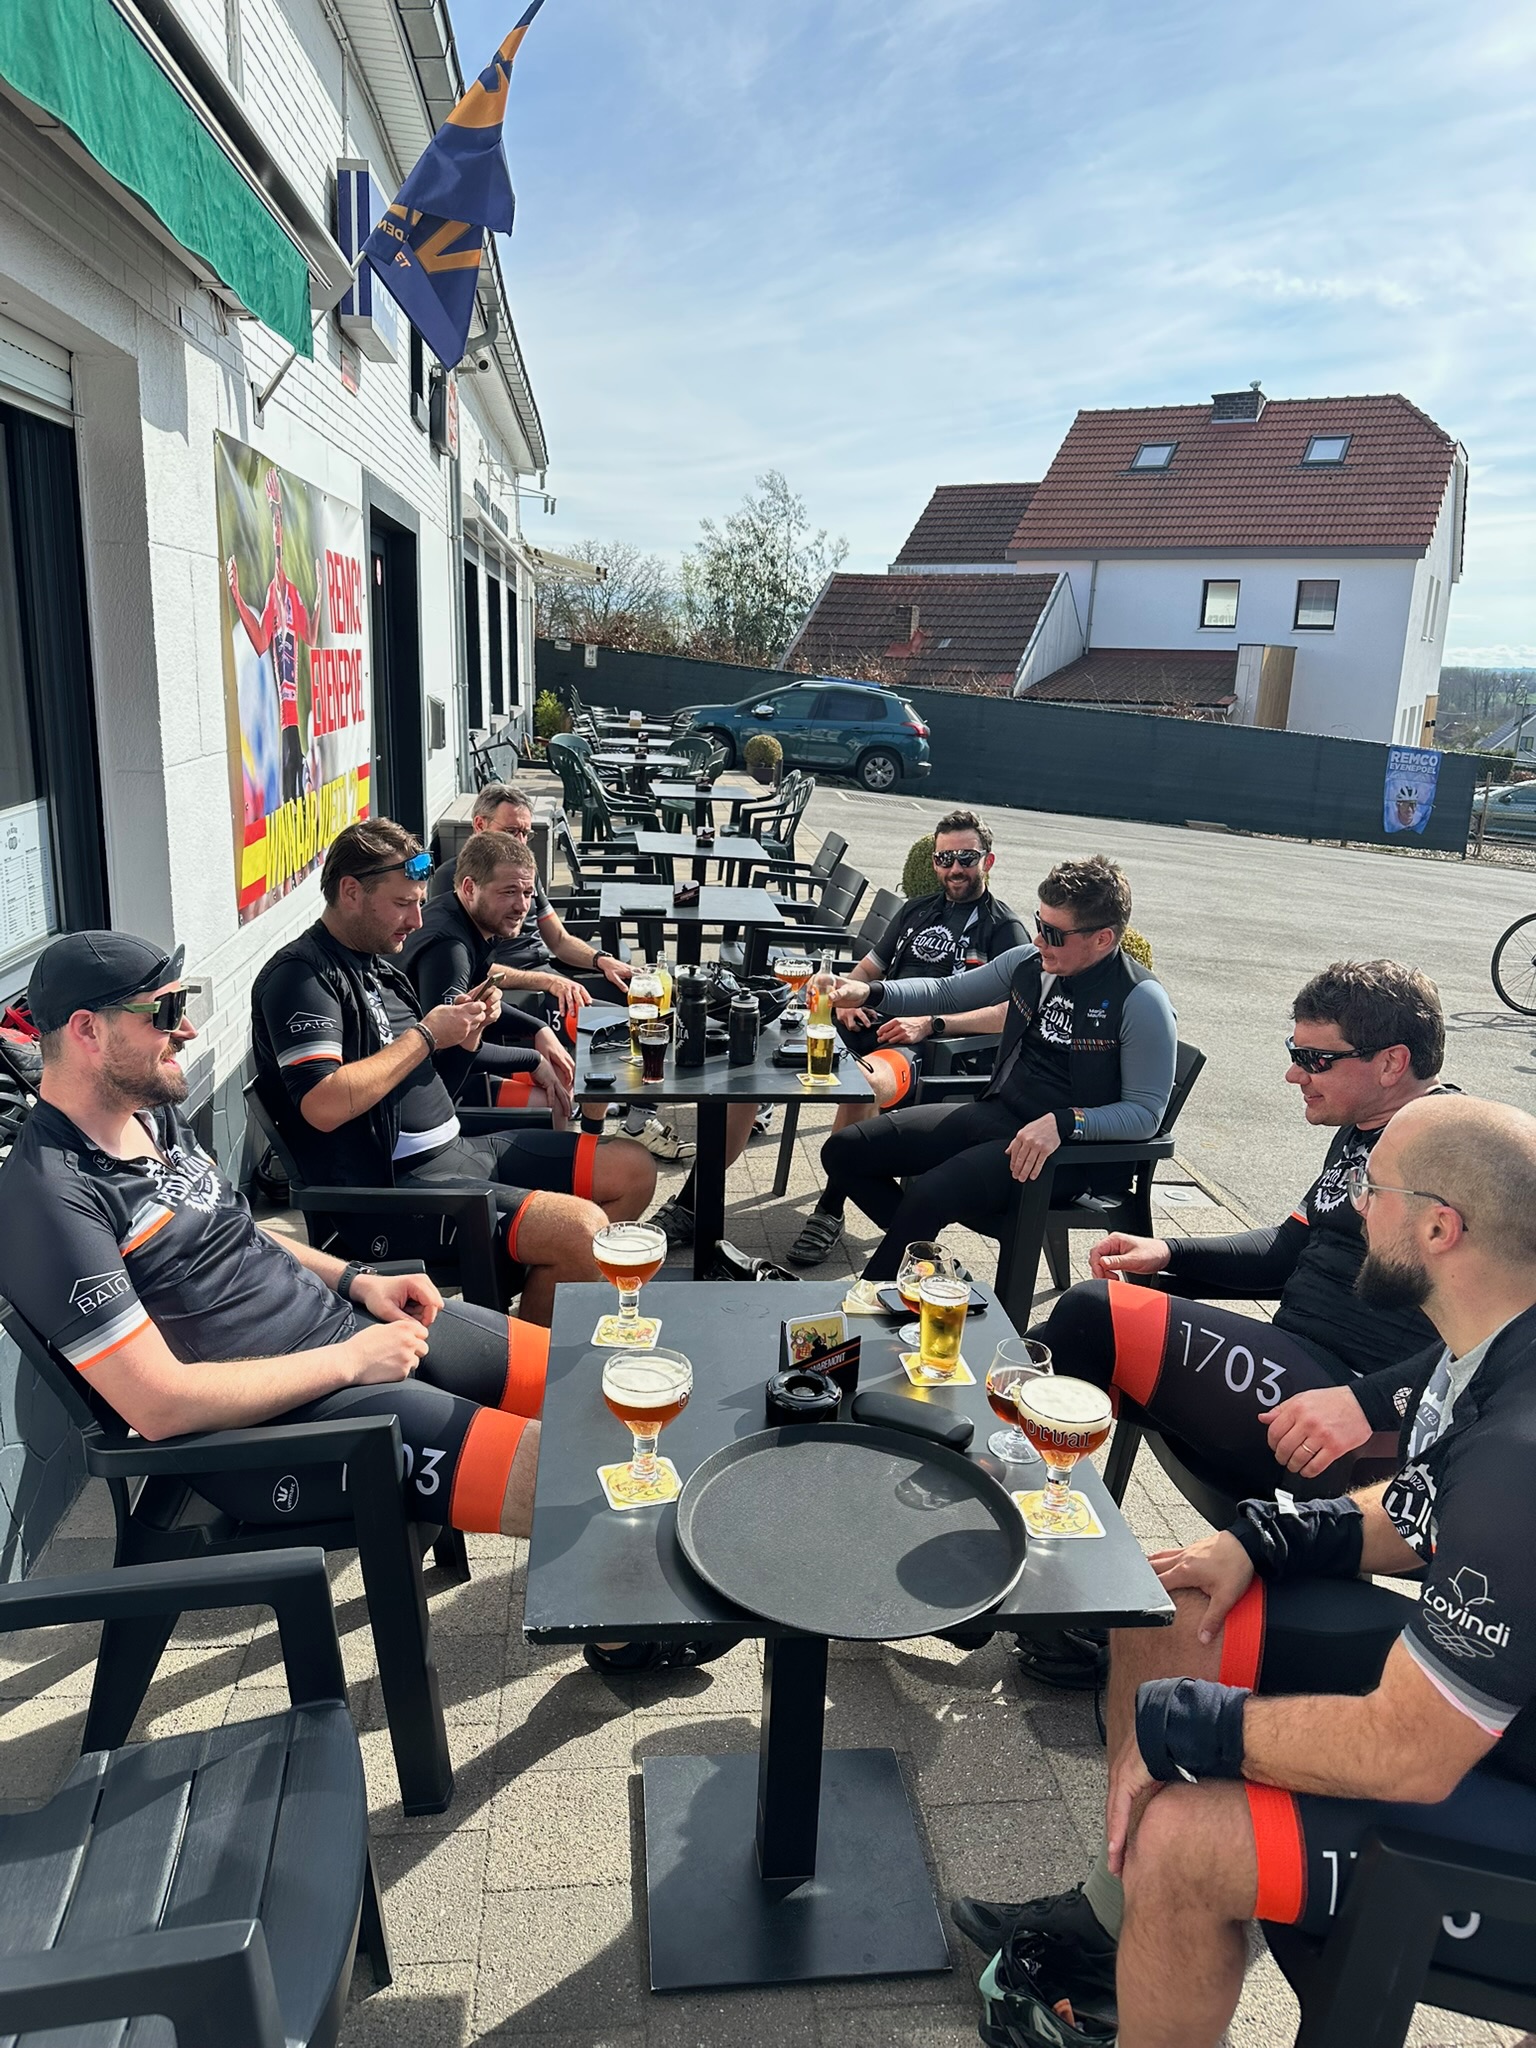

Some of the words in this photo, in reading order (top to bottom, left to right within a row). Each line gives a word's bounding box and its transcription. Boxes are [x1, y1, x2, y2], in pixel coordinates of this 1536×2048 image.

[310, 648, 365, 737] EVENEPOEL
[1389, 762, 1436, 775] EVENEPOEL
[1390, 750, 1438, 767] REMCO
[265, 790, 318, 894] WINNAAR
[1181, 1320, 1287, 1408] 1703
